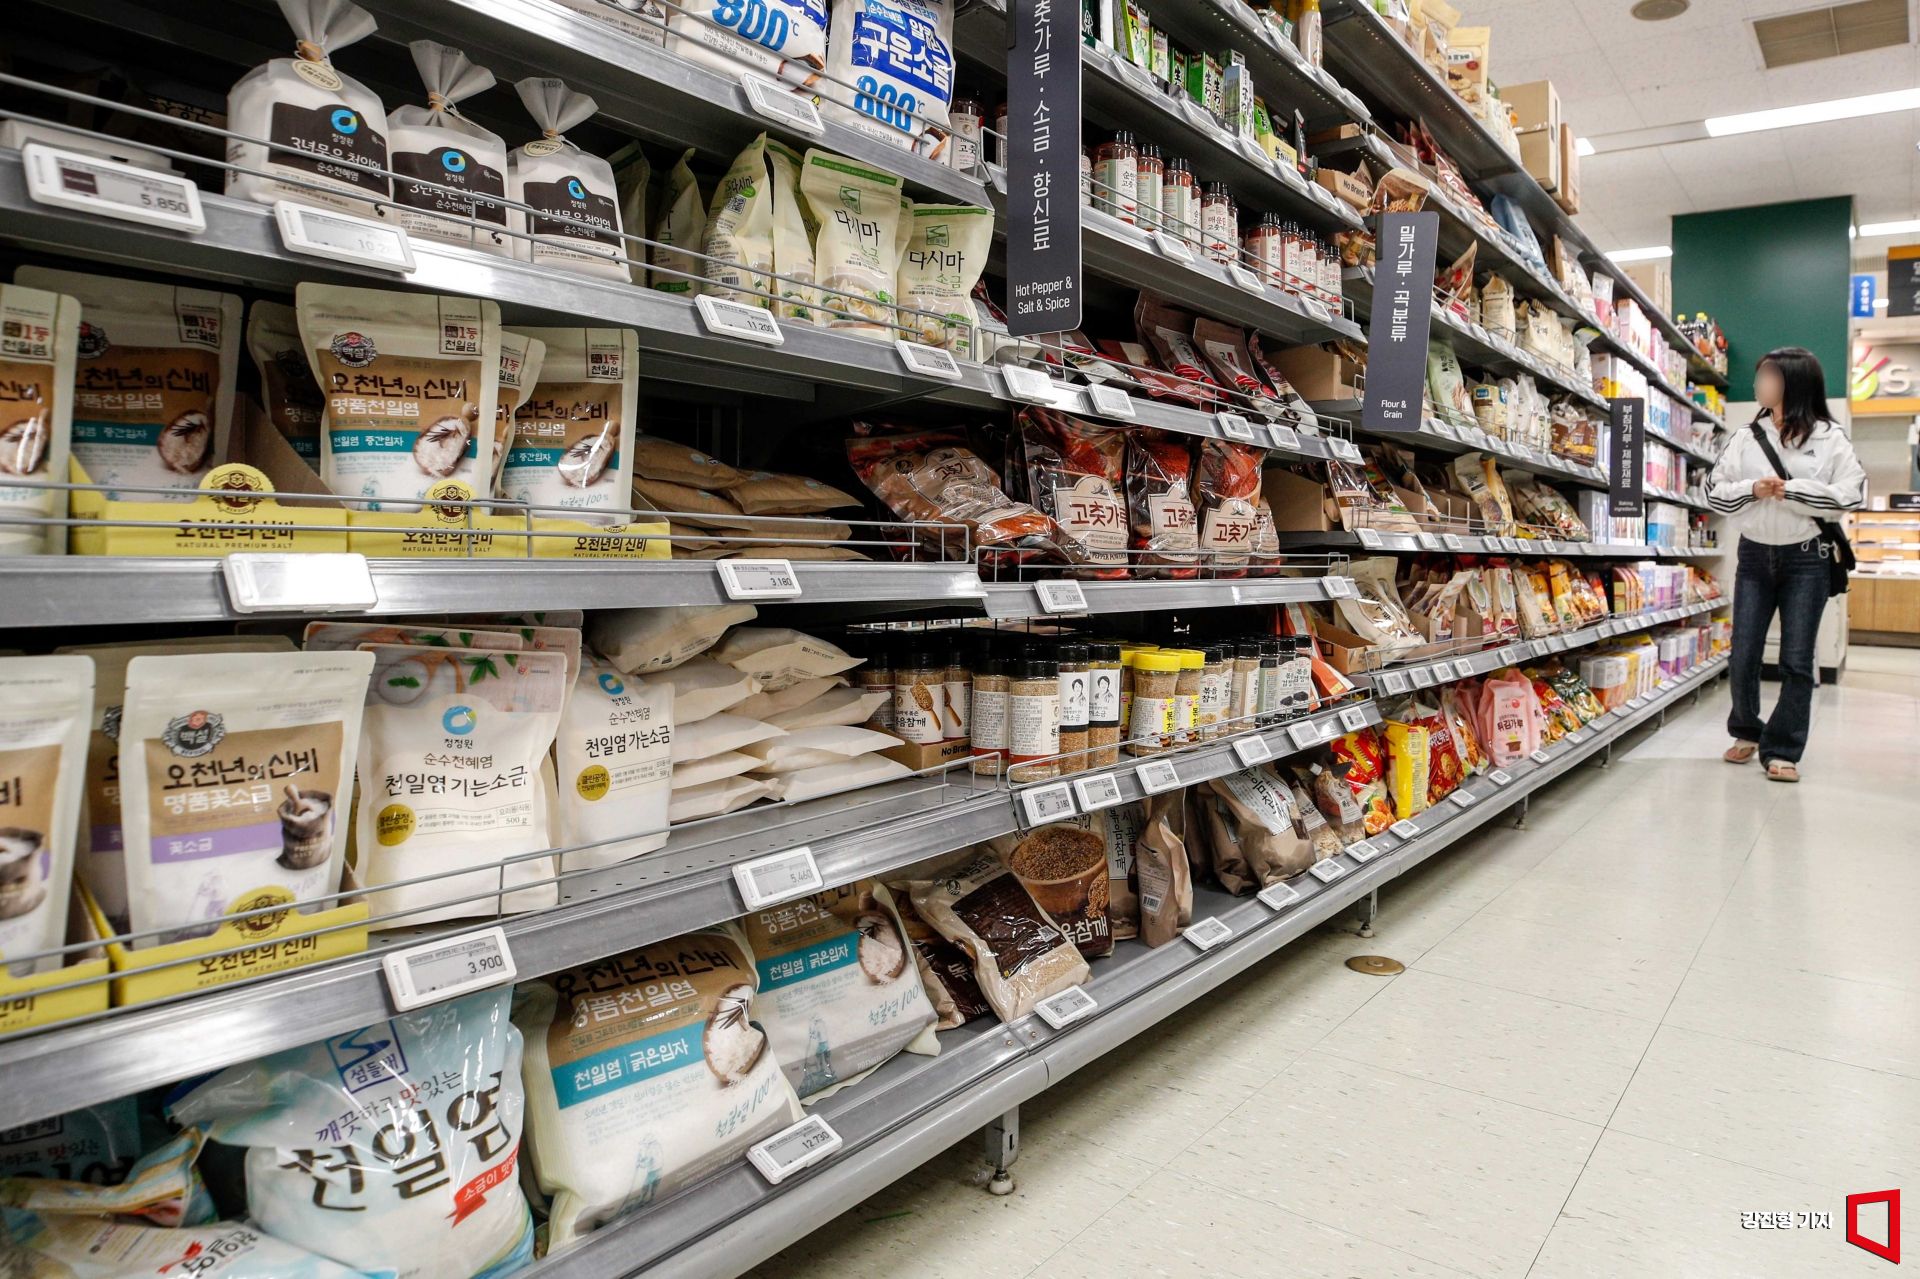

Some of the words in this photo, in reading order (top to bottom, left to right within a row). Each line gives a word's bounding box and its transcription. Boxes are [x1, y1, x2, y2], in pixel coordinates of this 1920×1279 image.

[860, 20, 949, 95] 구운소금
[331, 133, 354, 147] 청정원
[317, 161, 360, 182] 순수천혜염
[444, 172, 465, 184] 청정원
[1344, 179, 1350, 188] No
[1350, 182, 1364, 198] Brand
[834, 209, 881, 247] 다시마
[909, 250, 965, 274] 다시마
[935, 273, 962, 289] 소금
[1016, 282, 1030, 298] Hot
[1032, 279, 1063, 295] Pepper
[1065, 276, 1073, 288] &
[1018, 299, 1035, 315] Salt
[1037, 298, 1043, 311] &
[1045, 296, 1070, 312] Spice
[458, 325, 478, 341] 1등
[445, 338, 477, 354] 천일염
[591, 365, 619, 377] 천일염
[167, 368, 211, 395] 신비
[424, 377, 468, 402] 신비
[331, 399, 421, 418] 명품천일염
[571, 401, 609, 421] 신비
[1381, 399, 1400, 409] Flour
[1401, 400, 1407, 409] &
[1383, 409, 1403, 419] Grain
[574, 537, 624, 551] 오천년의
[626, 537, 648, 552] 신비
[611, 696, 632, 707] 청정원
[608, 706, 650, 726] 순수천혜염
[1497, 718, 1524, 732] 튀김가루
[444, 738, 473, 750] 청정원
[585, 734, 626, 759] 천일염
[628, 725, 670, 750] 가는소금
[941, 747, 952, 757] No
[953, 745, 971, 756] Bran
[268, 748, 319, 780] 신비
[424, 752, 493, 769] 순수천혜염
[385, 773, 446, 797] 천일염
[450, 765, 528, 798] 가는소금
[163, 784, 272, 815] 명품꽃소금
[506, 816, 520, 825] 500
[169, 837, 213, 855] 꽃소금
[790, 869, 814, 884] 5,460
[1060, 915, 1109, 946] 음참깨
[467, 955, 503, 974] 3,900
[676, 950, 741, 977] 신비
[769, 959, 804, 981] 천일염
[808, 944, 849, 970] 굵은입자
[572, 979, 698, 1029] 명품천일염
[574, 1058, 622, 1092] 천일염
[629, 1037, 689, 1074] 굵은입자
[315, 1095, 399, 1143] 깨끗하고
[399, 1071, 462, 1108] 맛있는
[279, 1069, 512, 1212] 천일염
[801, 1131, 831, 1151] 12,730
[463, 1172, 497, 1202] 소금이
